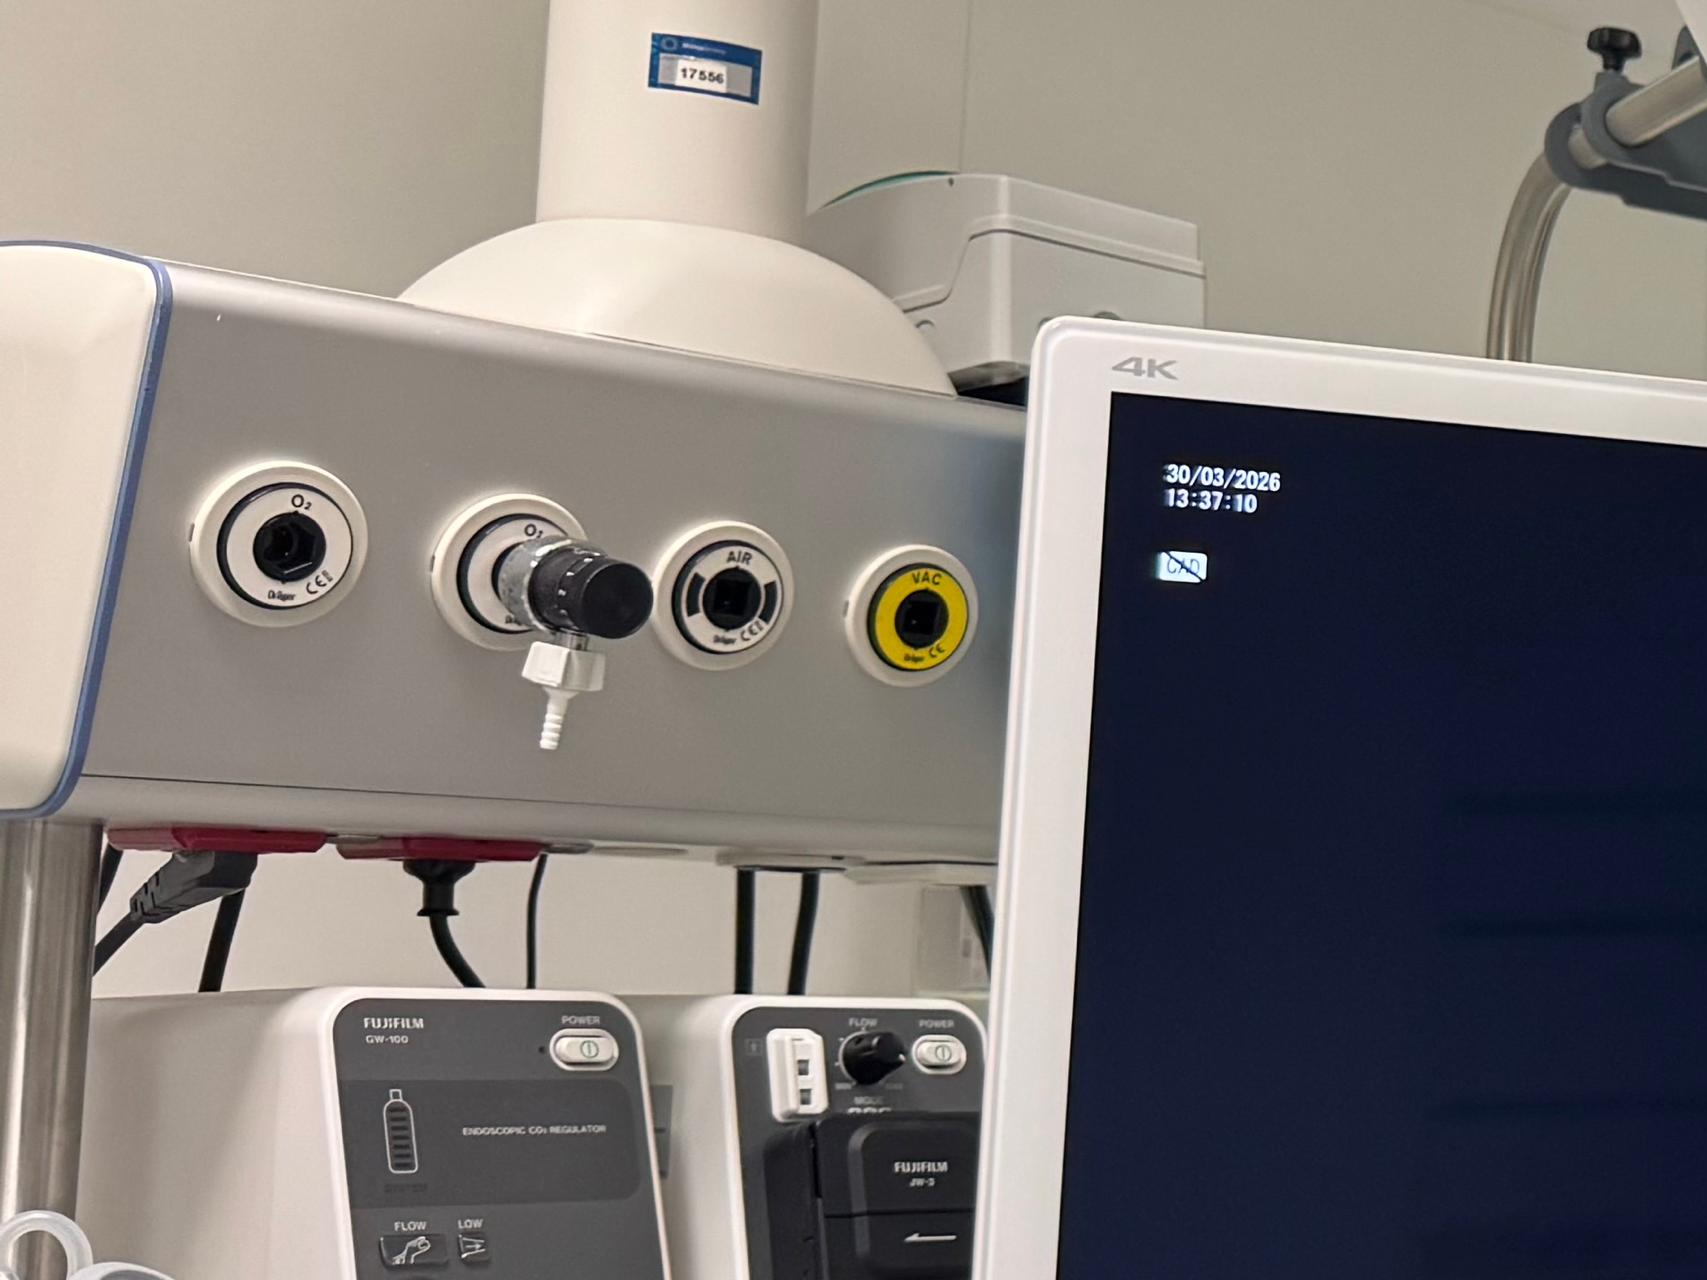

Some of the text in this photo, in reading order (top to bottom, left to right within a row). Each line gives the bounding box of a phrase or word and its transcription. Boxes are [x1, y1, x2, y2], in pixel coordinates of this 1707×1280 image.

[681, 67, 724, 84] 17556
[1111, 356, 1178, 381] 4K
[1165, 464, 1281, 492] 30/03/2026
[1166, 488, 1257, 513] 13:37:10
[726, 550, 753, 565] AIR
[912, 571, 942, 586] VAC
[363, 1017, 424, 1029] FUJIFILM
[561, 1015, 600, 1025] POWER
[365, 1035, 409, 1045] GW-100
[462, 1126, 526, 1136] ENDOSCOPIC
[549, 1124, 607, 1134] REGULATOR
[894, 1161, 948, 1173] FUJIFILM
[394, 1221, 427, 1232] FLOW
[457, 1219, 484, 1230] LOW
